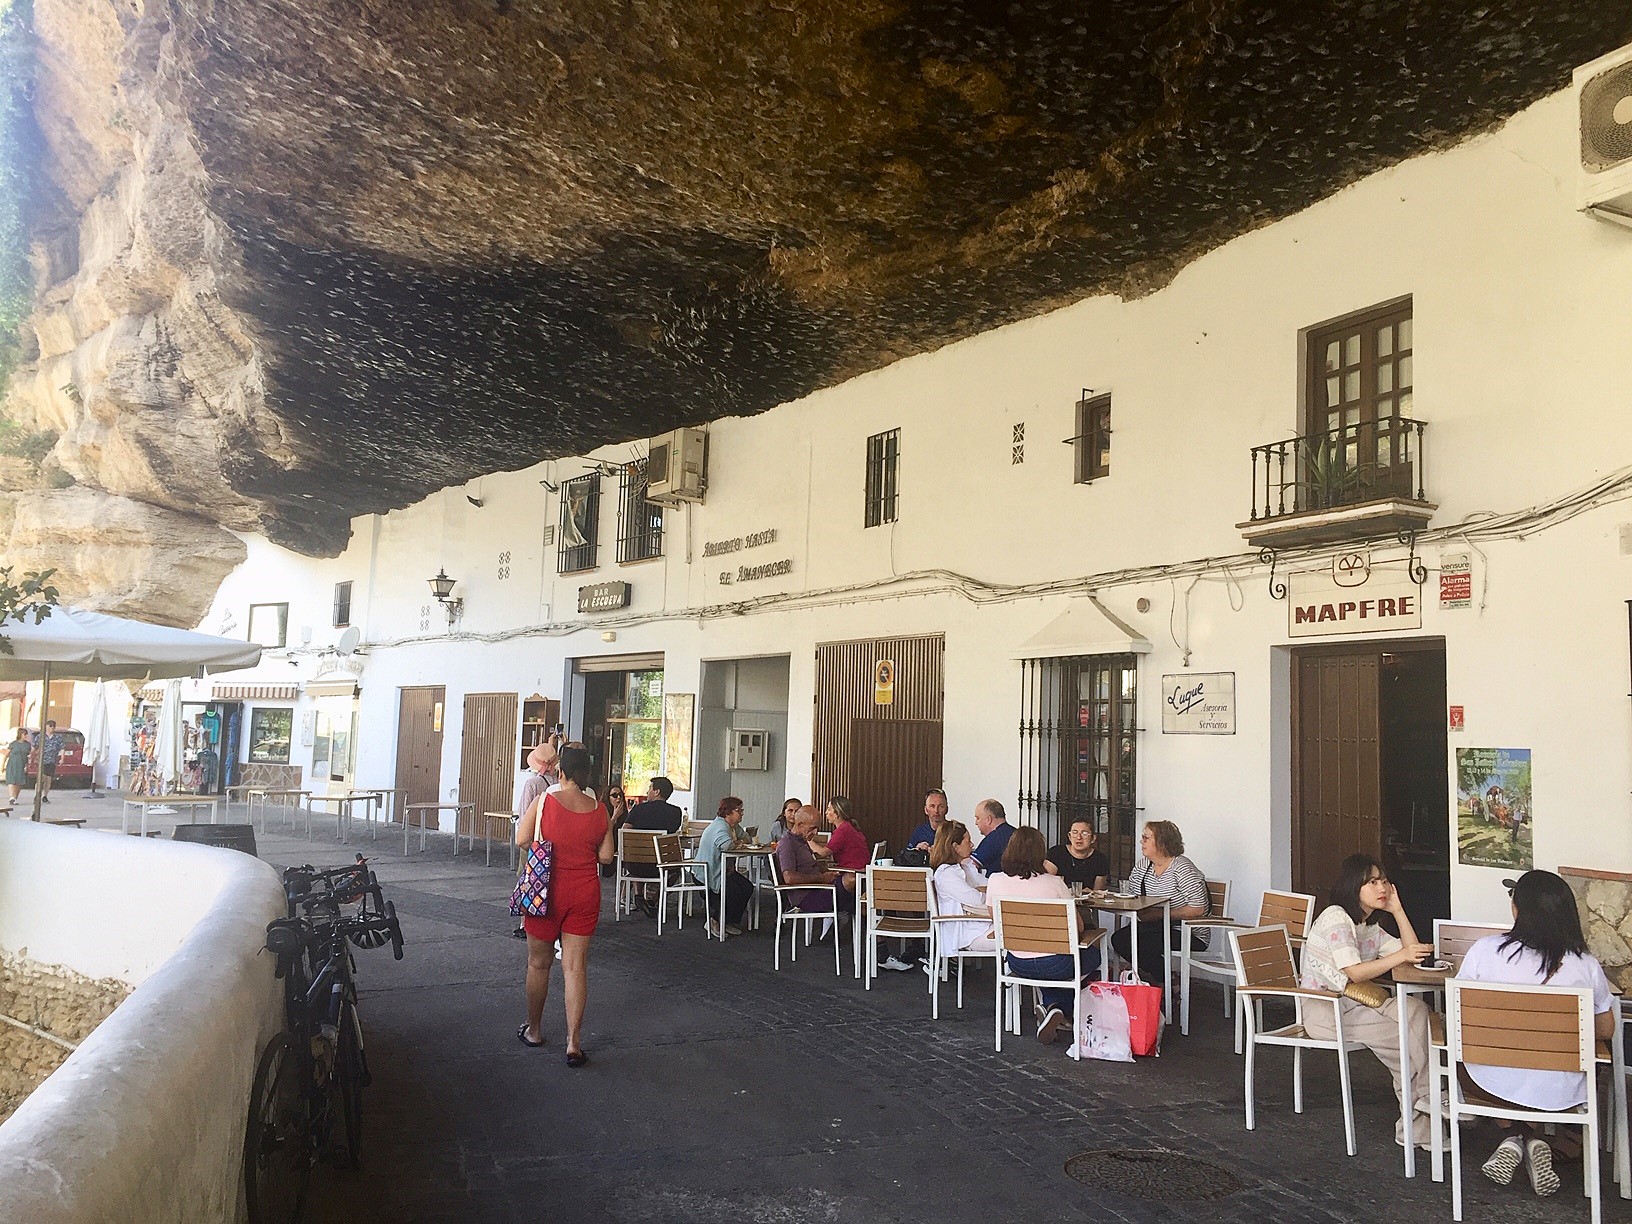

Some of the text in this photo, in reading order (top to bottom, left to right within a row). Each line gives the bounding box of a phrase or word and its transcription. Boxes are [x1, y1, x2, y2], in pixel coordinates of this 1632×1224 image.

[744, 528, 778, 549] HASTA
[594, 587, 609, 597] BAR
[581, 598, 589, 609] LA
[1295, 596, 1414, 624] MAPFRE
[1167, 682, 1204, 714] Luque
[1198, 719, 1228, 729] Servicios
